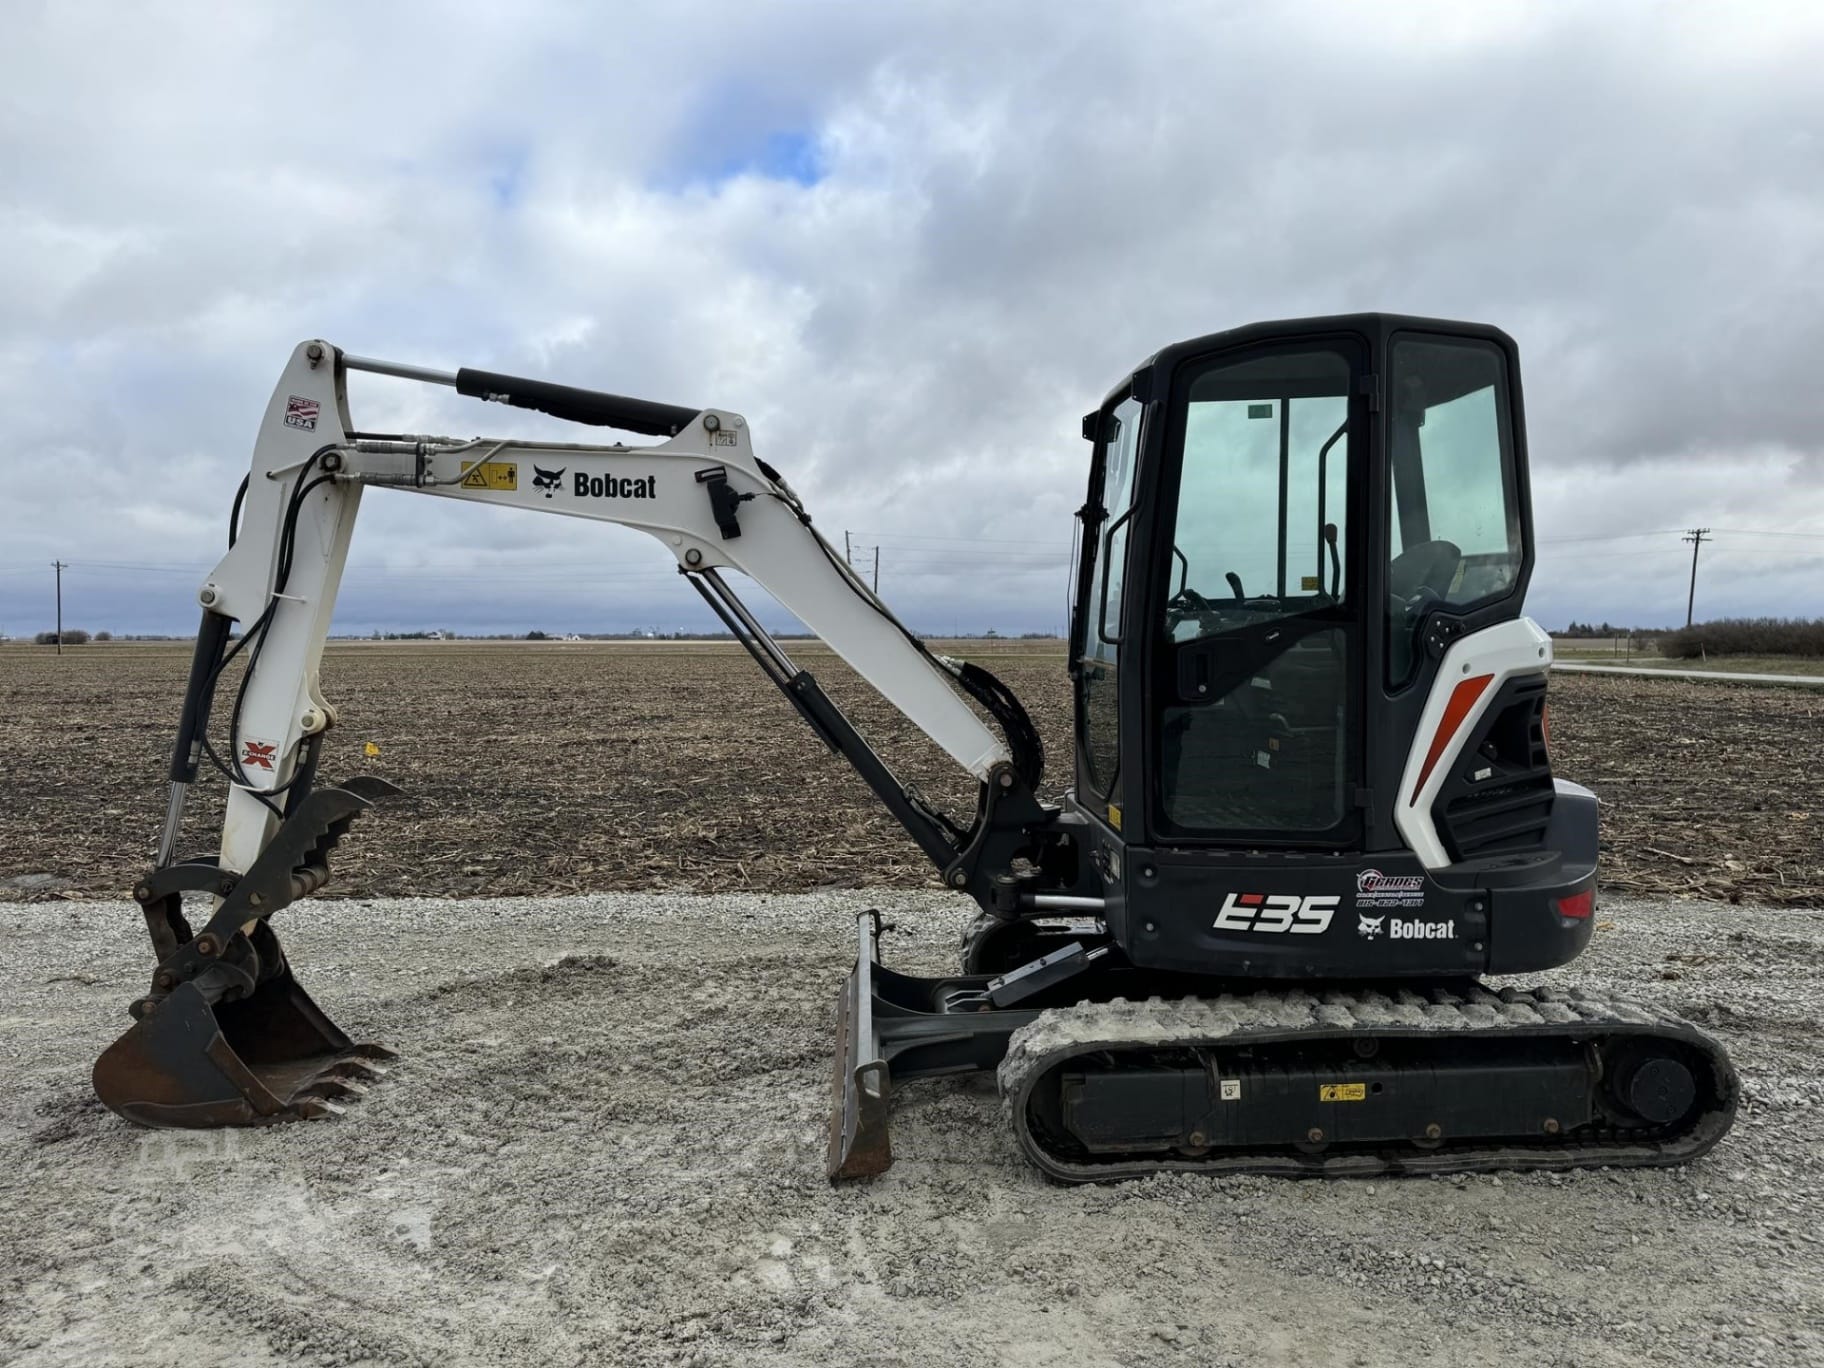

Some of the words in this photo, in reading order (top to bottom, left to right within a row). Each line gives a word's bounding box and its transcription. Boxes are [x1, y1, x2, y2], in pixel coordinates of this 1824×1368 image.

[287, 416, 313, 428] USA
[574, 472, 656, 499] Bobcat
[1212, 893, 1341, 934] E35
[1390, 919, 1454, 939] Bobcat
